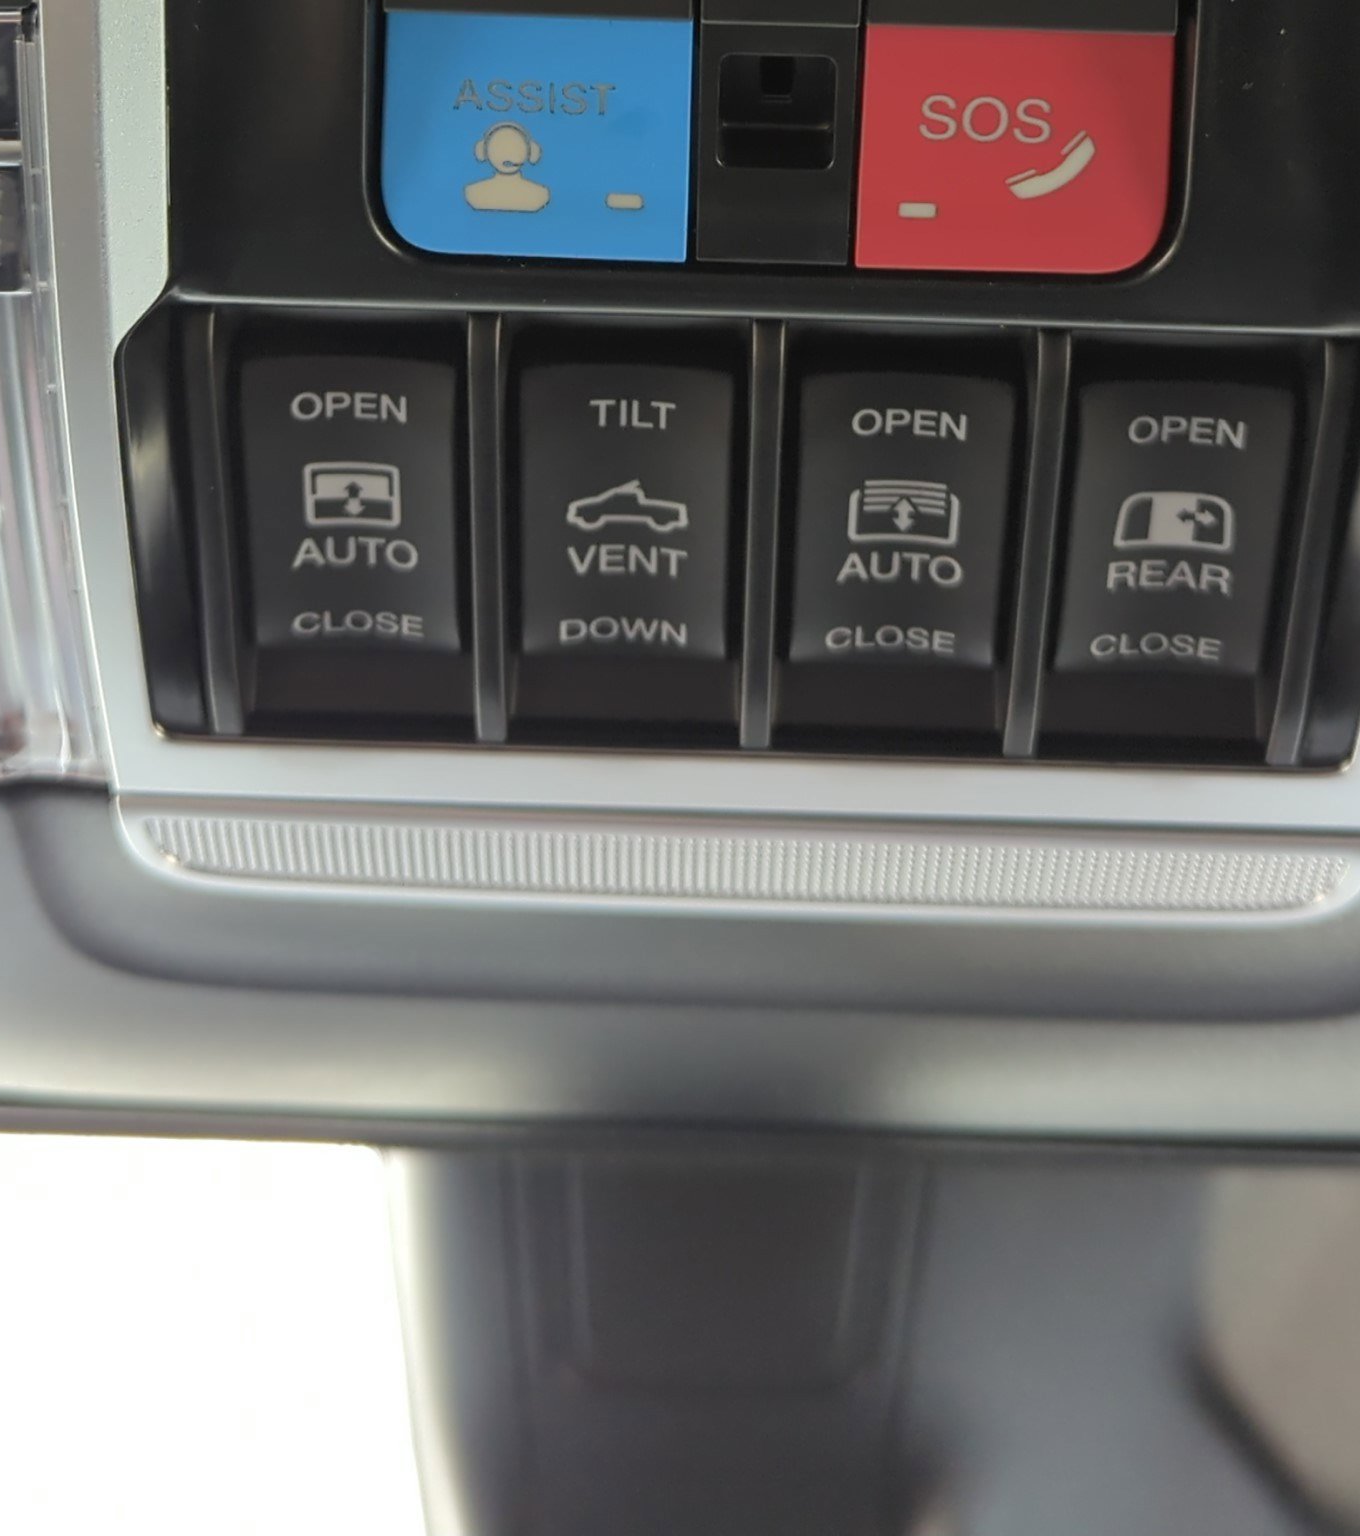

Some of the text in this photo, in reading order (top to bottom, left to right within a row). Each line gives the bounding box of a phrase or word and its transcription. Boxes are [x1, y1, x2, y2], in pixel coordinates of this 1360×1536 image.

[452, 78, 618, 116] ASSIST
[918, 94, 1053, 144] SOS
[290, 391, 408, 424] OPEN
[588, 398, 677, 430] TILT
[851, 408, 968, 442] OPEN
[1127, 415, 1246, 450] OPEN
[292, 537, 419, 572] AUTO
[566, 544, 689, 578] VENT
[835, 551, 963, 587] AUTO
[1106, 560, 1232, 595] REAR
[291, 610, 425, 639] CLOSE
[558, 616, 689, 646] DOWN
[824, 625, 956, 654] CLOSE
[1089, 632, 1222, 662] CLOSE
